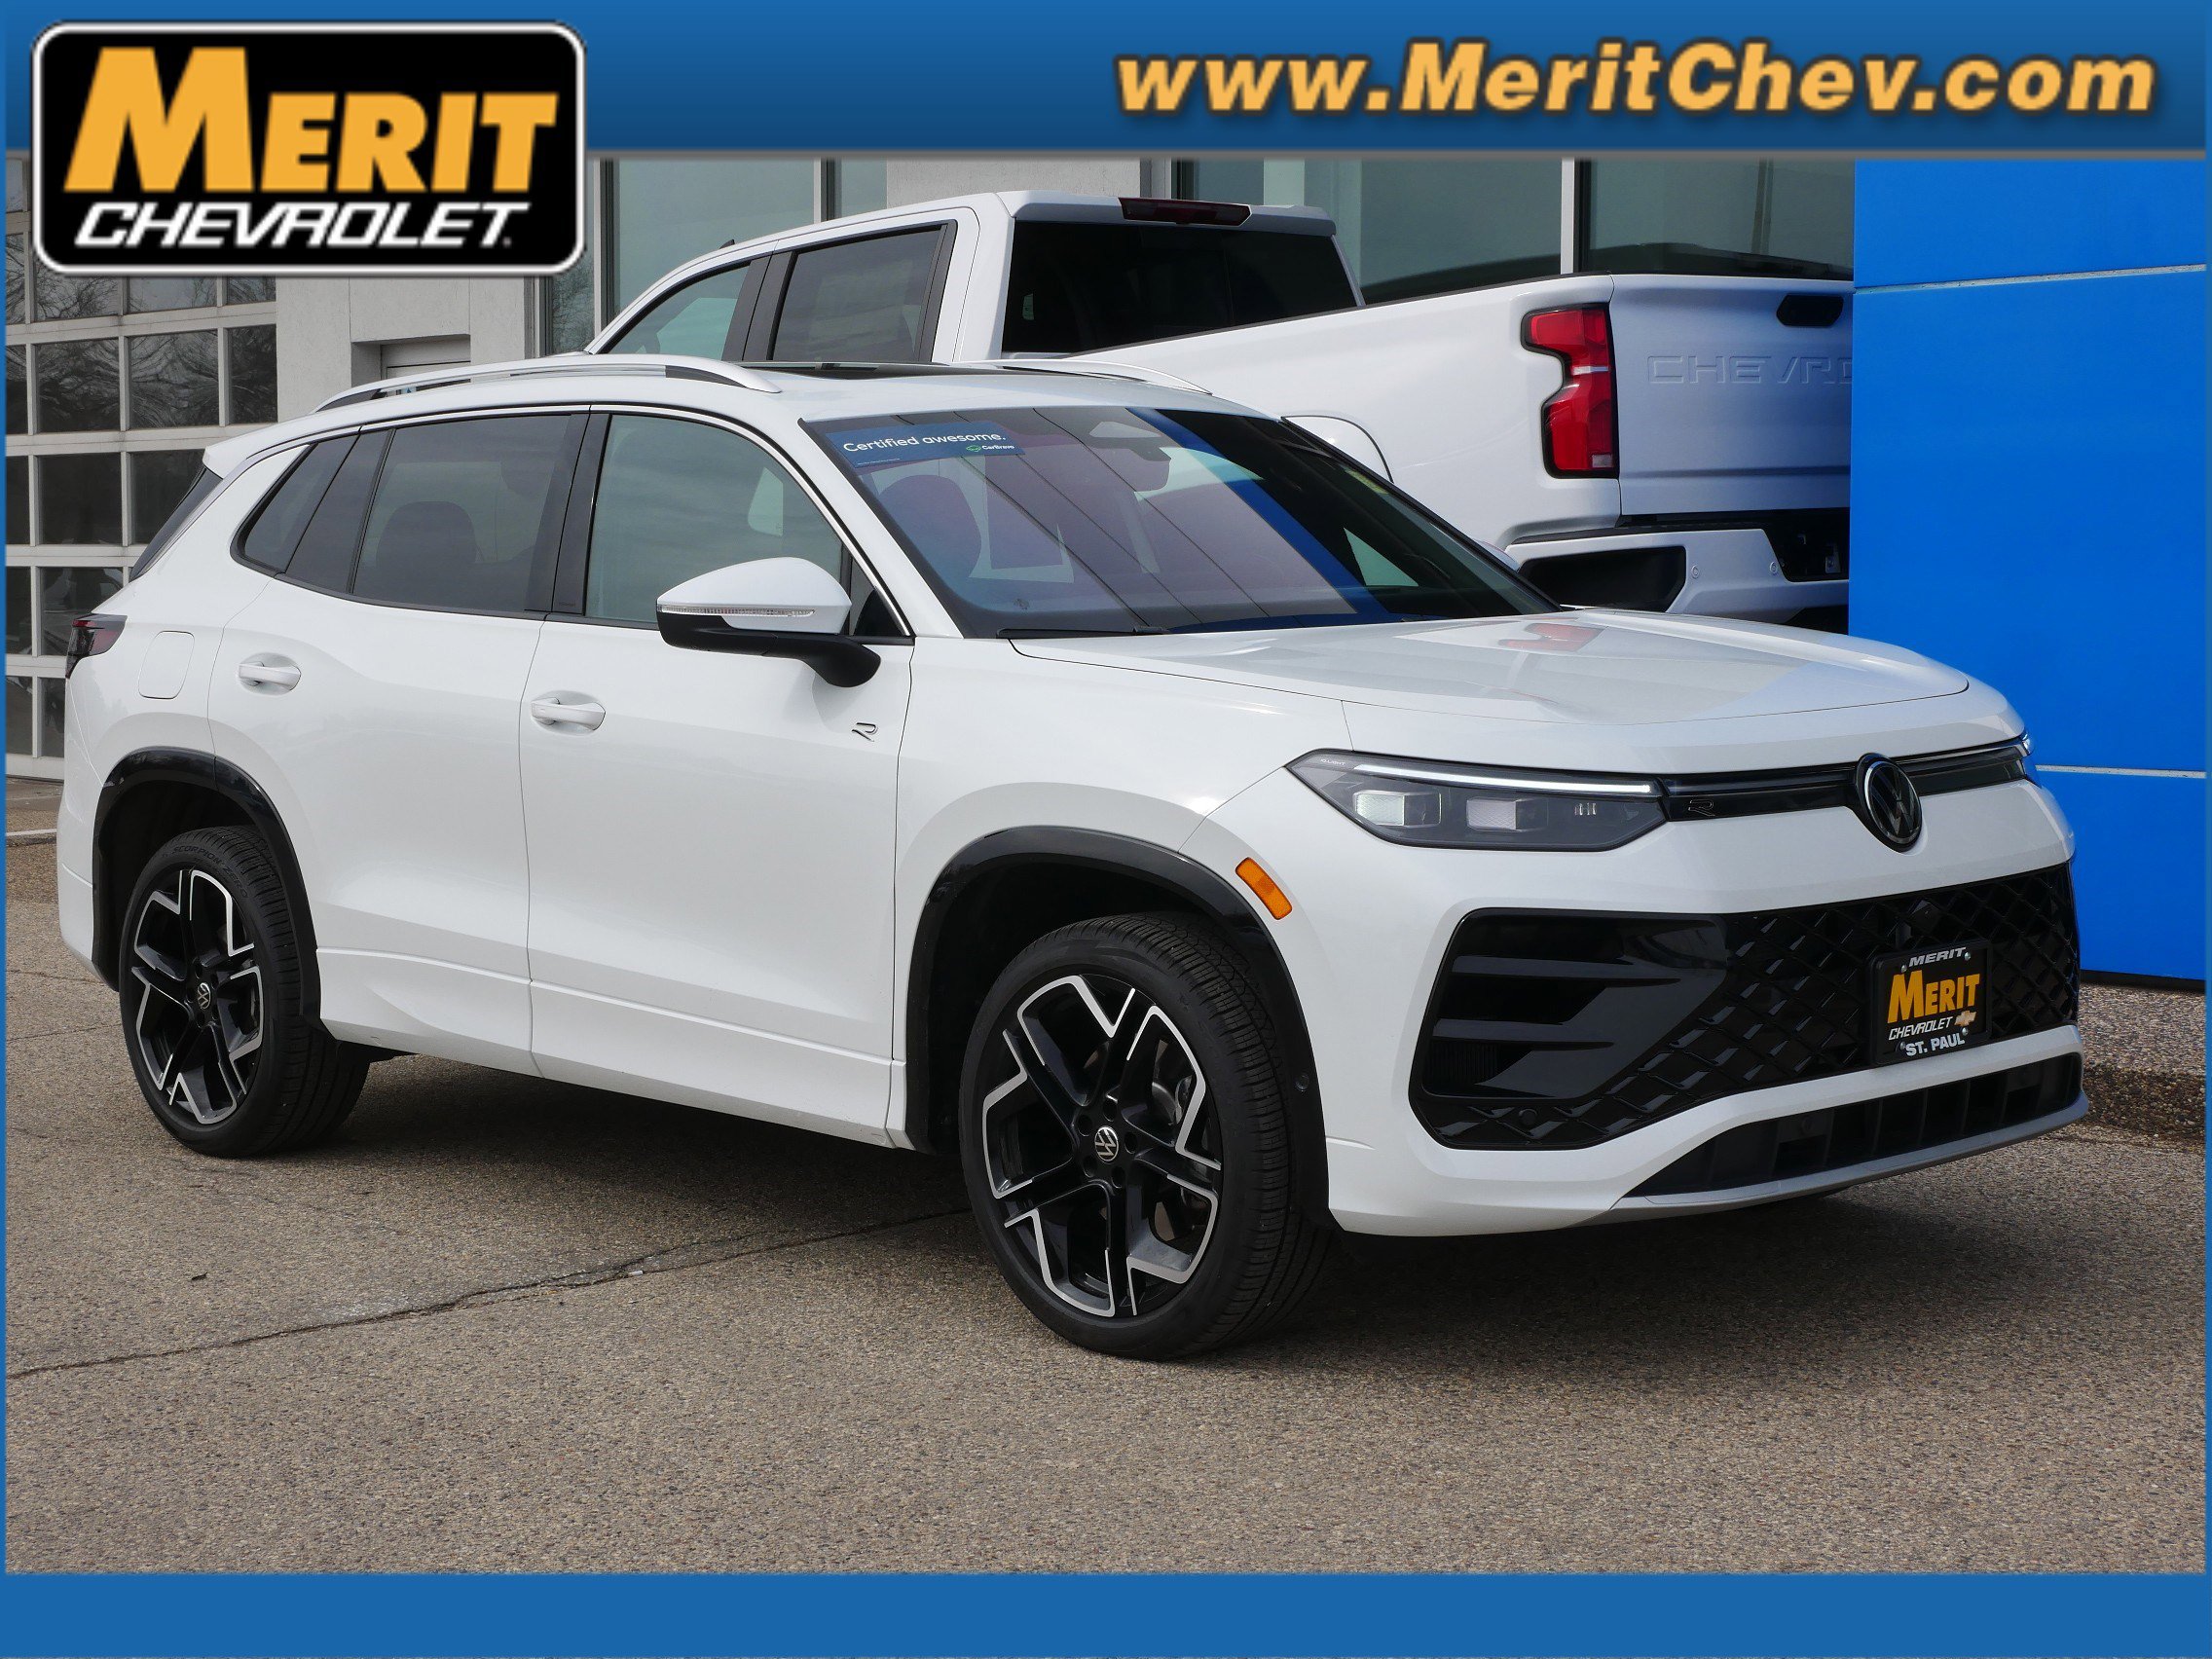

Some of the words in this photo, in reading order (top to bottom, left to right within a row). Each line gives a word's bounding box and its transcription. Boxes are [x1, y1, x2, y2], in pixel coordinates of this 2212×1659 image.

[843, 436, 920, 452] Certified
[922, 432, 1007, 444] awesome.
[1909, 946, 1966, 967] MERIT
[1888, 970, 1980, 1023] MERIT
[1889, 1016, 1953, 1041] CHEVROLET
[1905, 1041, 1928, 1056] ST.
[1931, 1032, 1966, 1051] PAUL
